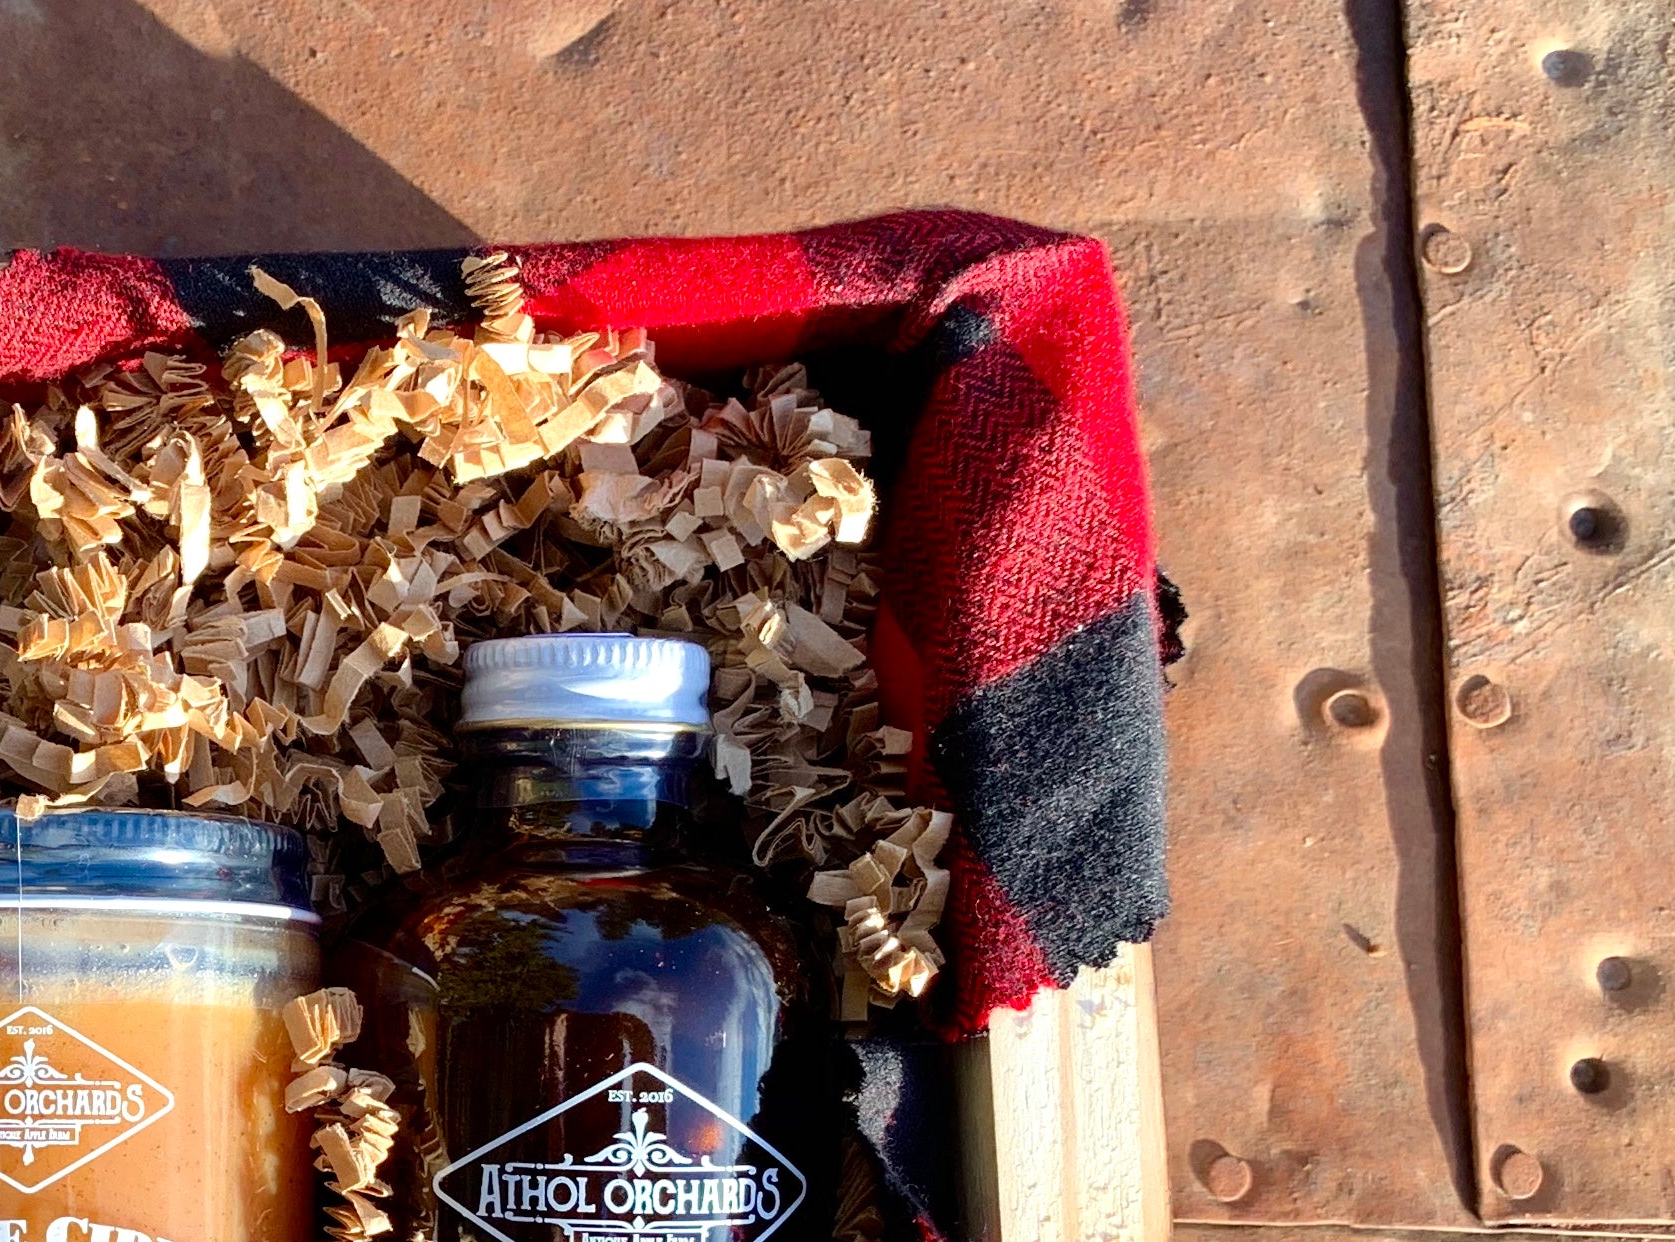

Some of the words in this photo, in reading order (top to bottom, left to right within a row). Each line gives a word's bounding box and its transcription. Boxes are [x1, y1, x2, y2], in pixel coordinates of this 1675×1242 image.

[6, 1025, 27, 1035] EST.
[28, 1024, 54, 1035] 2016
[4, 1084, 145, 1122] ORCHARDS
[608, 1089, 637, 1103] EST.
[639, 1088, 674, 1103] 2016
[476, 1164, 595, 1218] ATHOL
[603, 1167, 780, 1220] ORCHARDS
